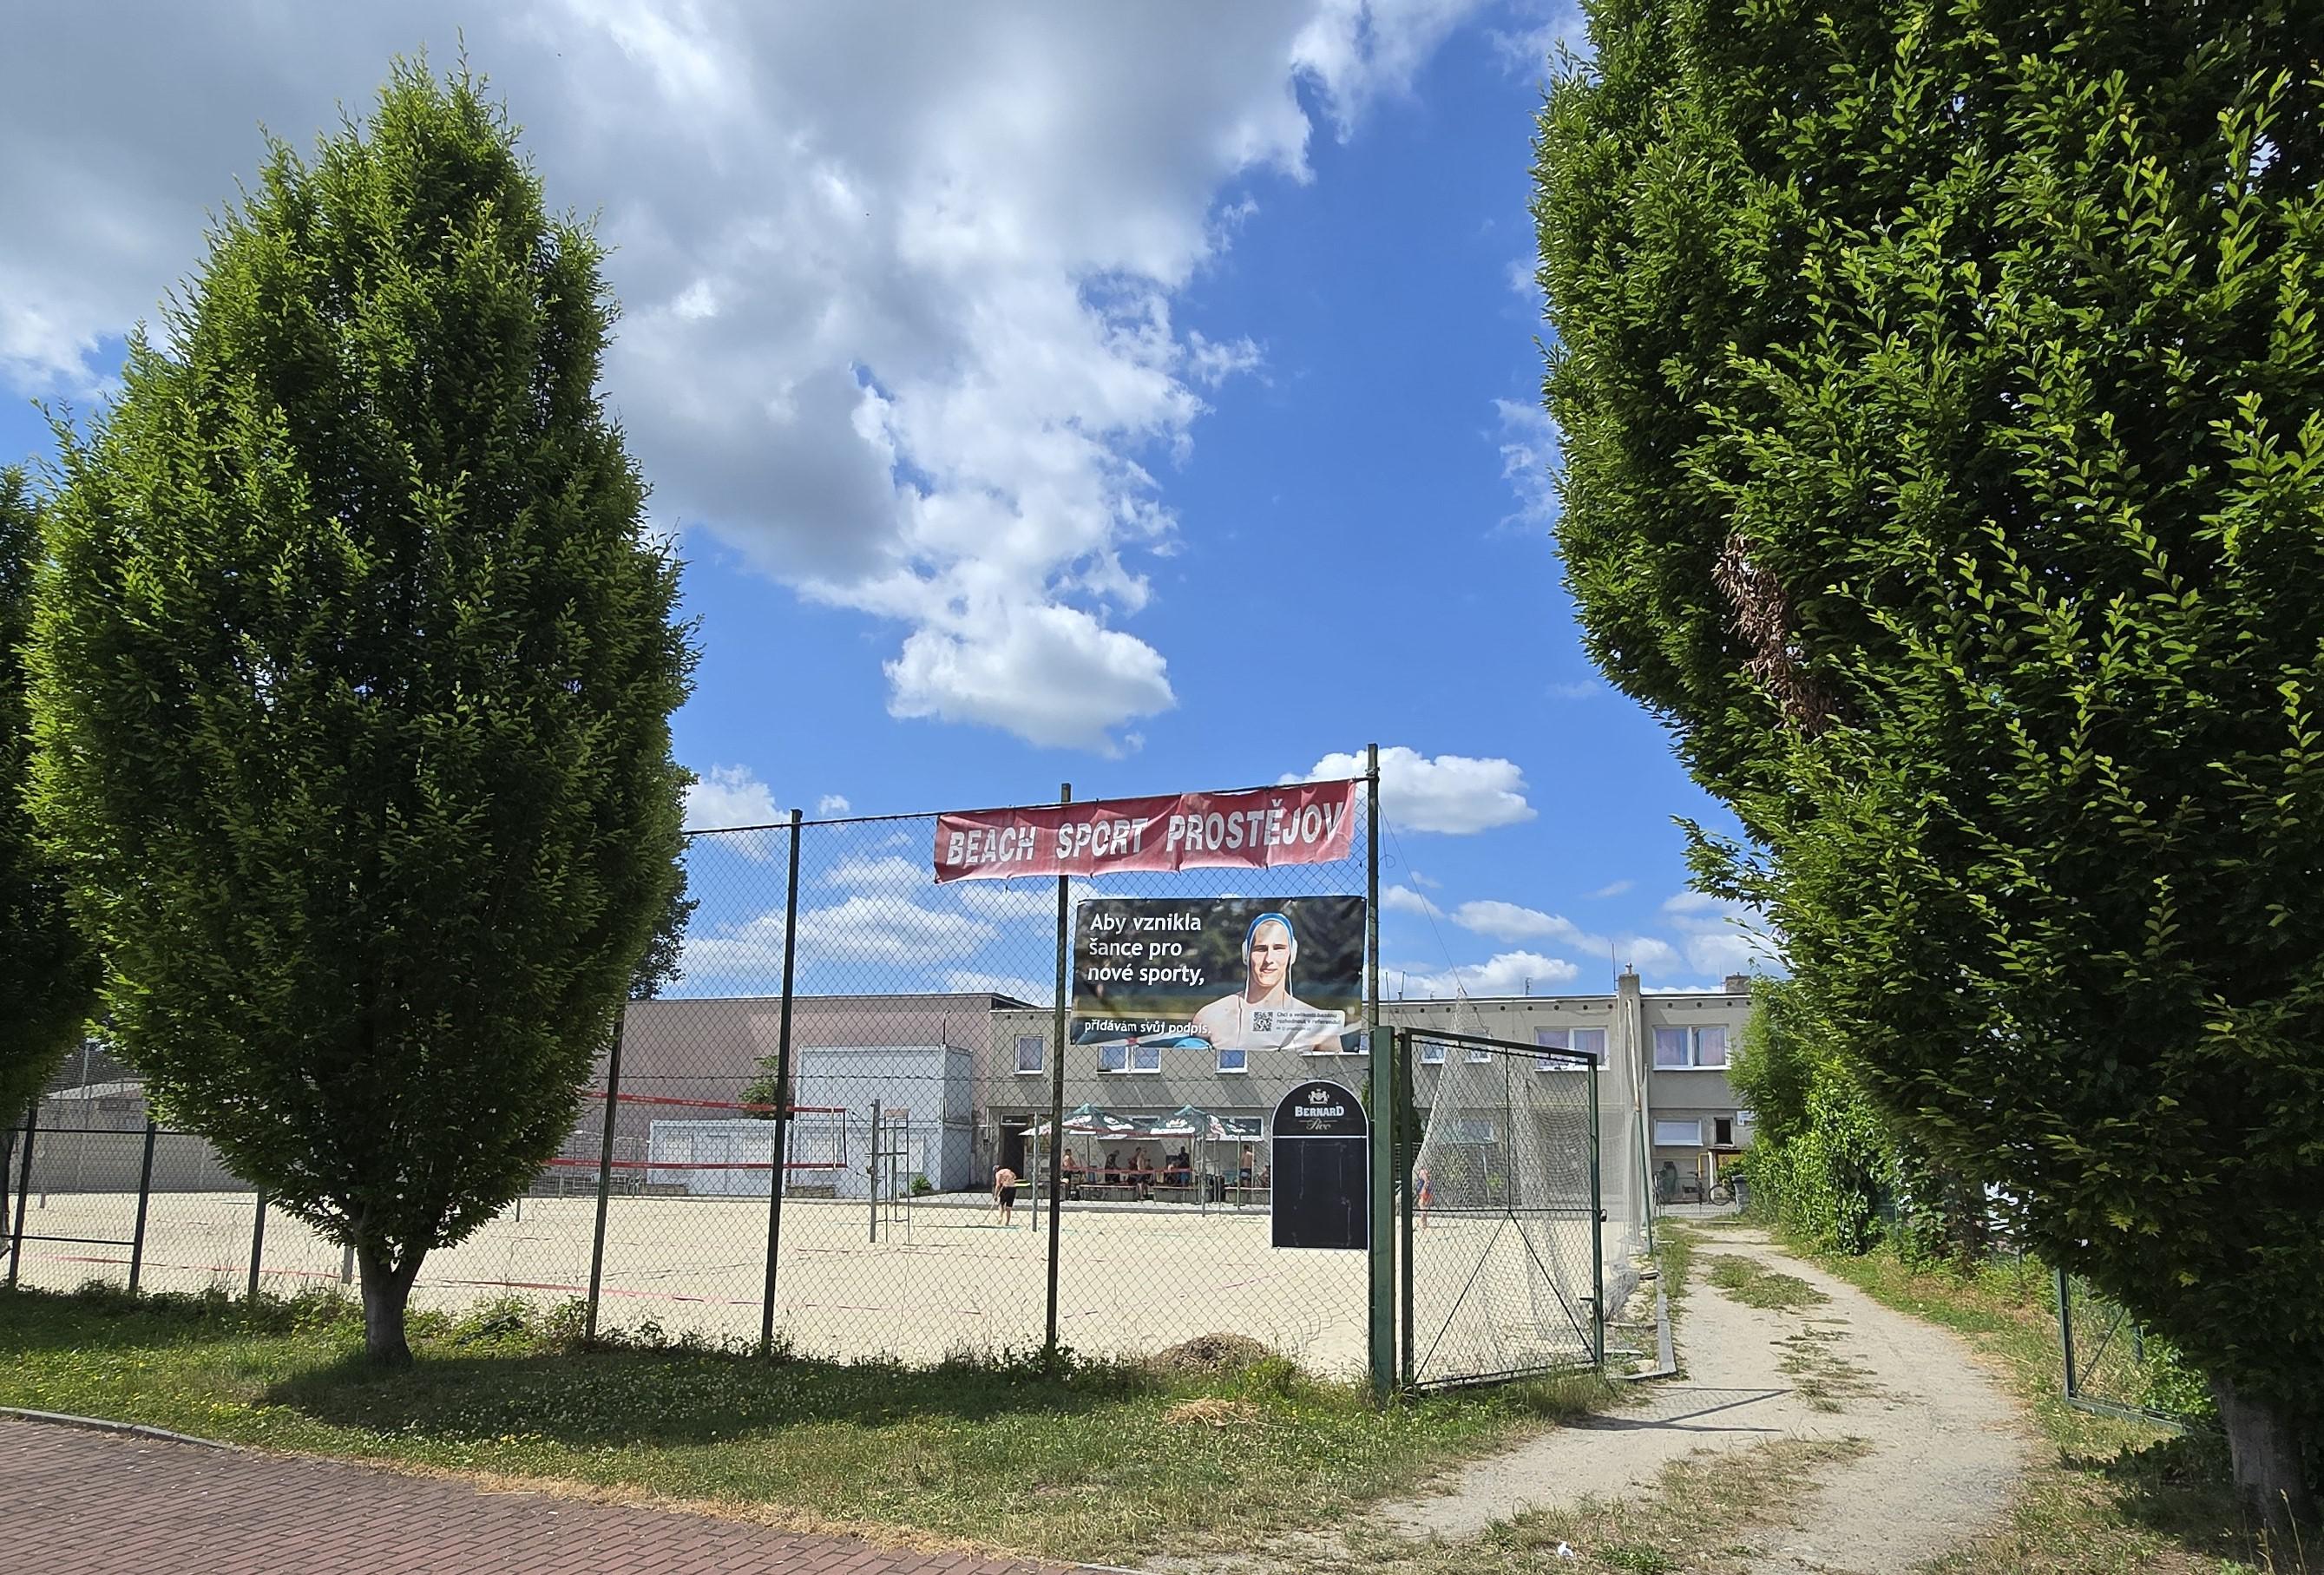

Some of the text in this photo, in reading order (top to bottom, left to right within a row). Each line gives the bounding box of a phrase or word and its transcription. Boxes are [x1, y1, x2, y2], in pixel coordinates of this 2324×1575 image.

[946, 798, 1344, 866] BEACH SPORT PROSTĚJOV
[1090, 913, 1202, 935] Aby vznikla
[1089, 937, 1182, 961] šance pro
[1087, 963, 1205, 987] nové sporty,
[1085, 1019, 1211, 1036] přidávám svůj podpis.
[1294, 1106, 1345, 1117] BERNARD
